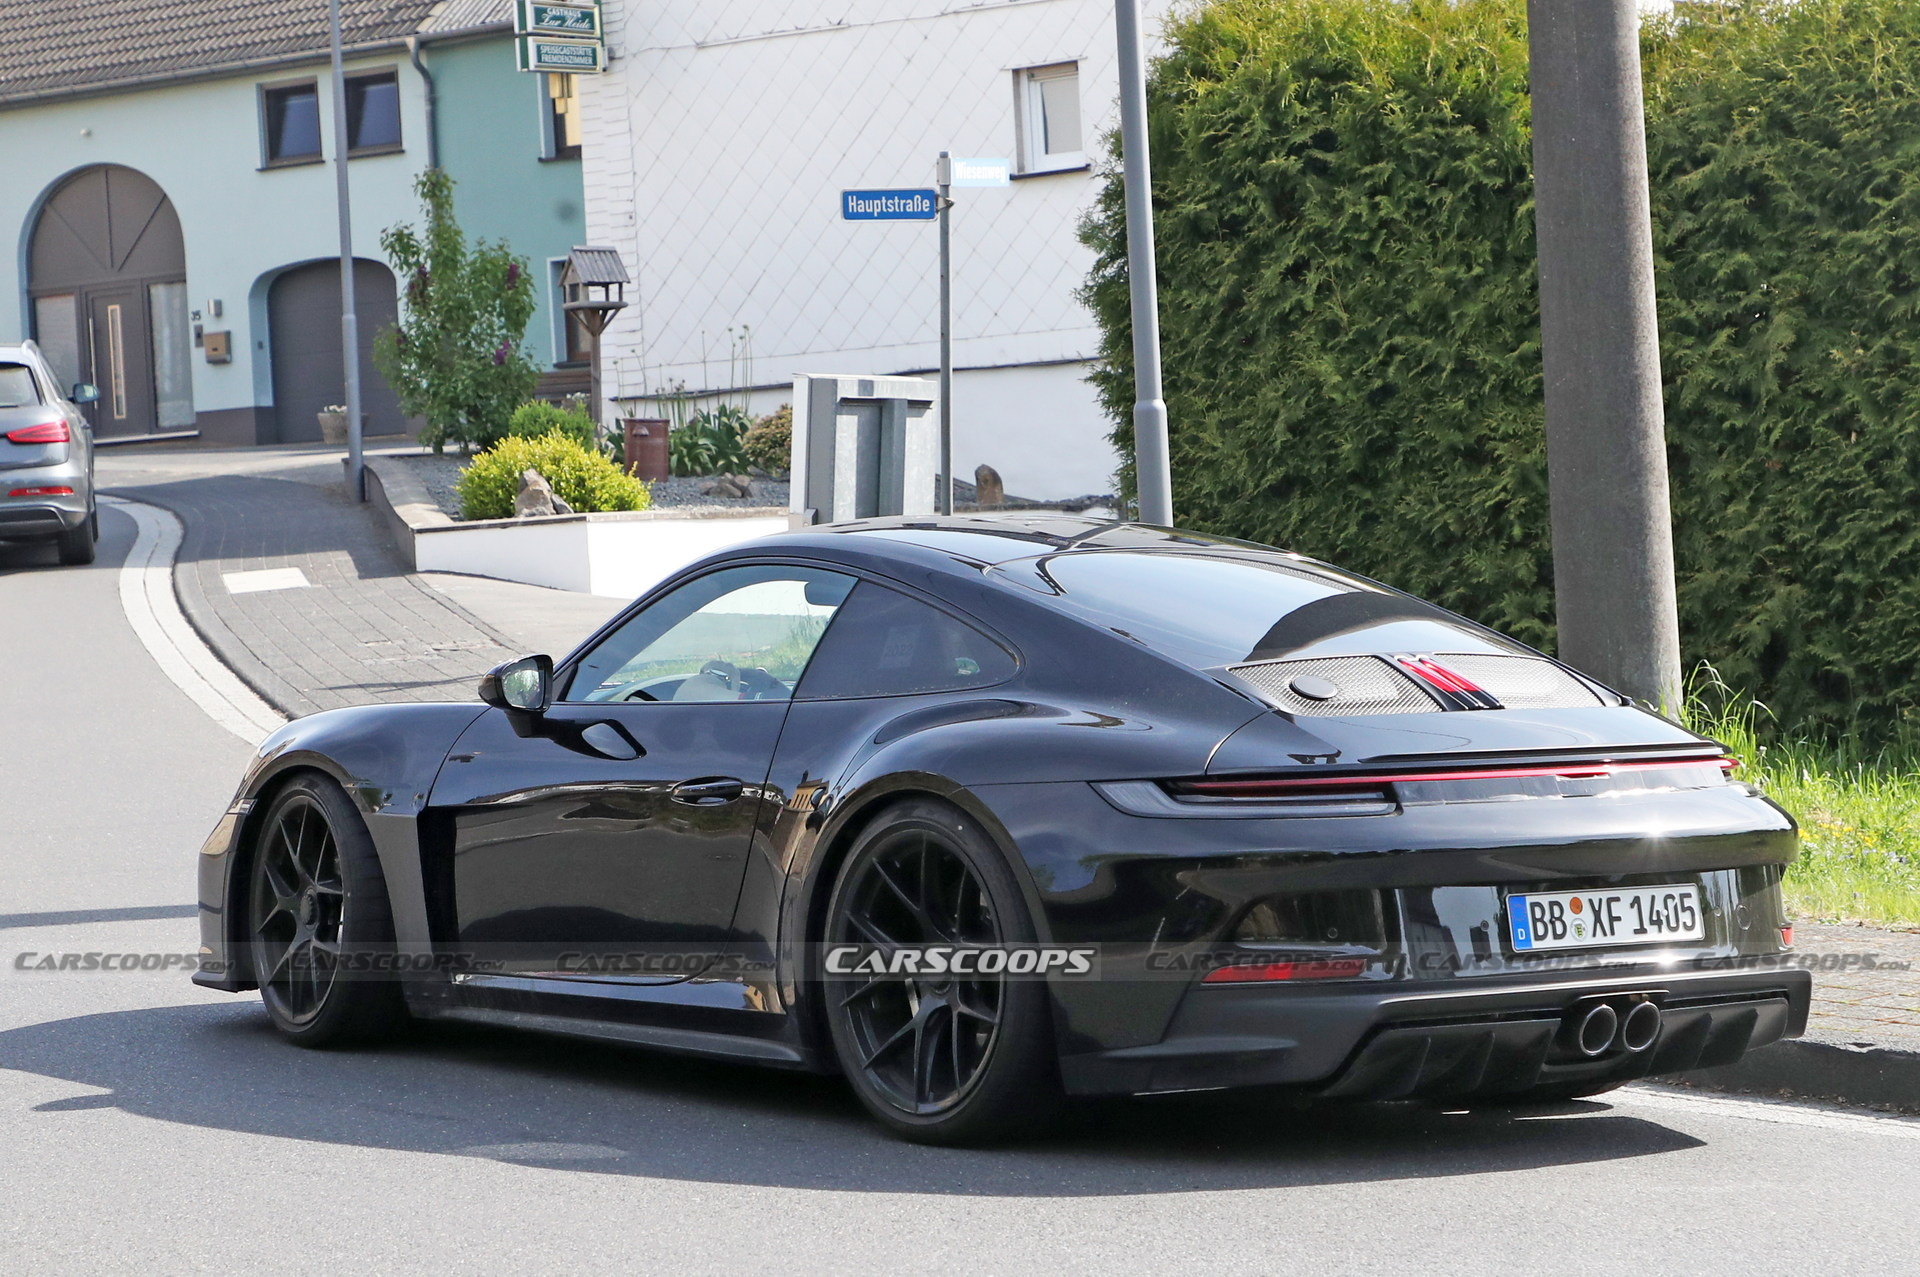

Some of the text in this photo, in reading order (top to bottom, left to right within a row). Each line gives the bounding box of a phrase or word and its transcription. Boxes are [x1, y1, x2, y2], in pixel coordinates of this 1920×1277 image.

[547, 7, 581, 17] GASTHAUS
[540, 14, 593, 29] Zur Heide
[541, 54, 593, 64] FREMDENZIMMER
[954, 161, 1006, 184] Wiesenweg
[848, 194, 930, 217] Hauptstraße
[191, 310, 201, 321] 35
[1529, 892, 1696, 942] BB XF 1405
[1518, 928, 1526, 940] D
